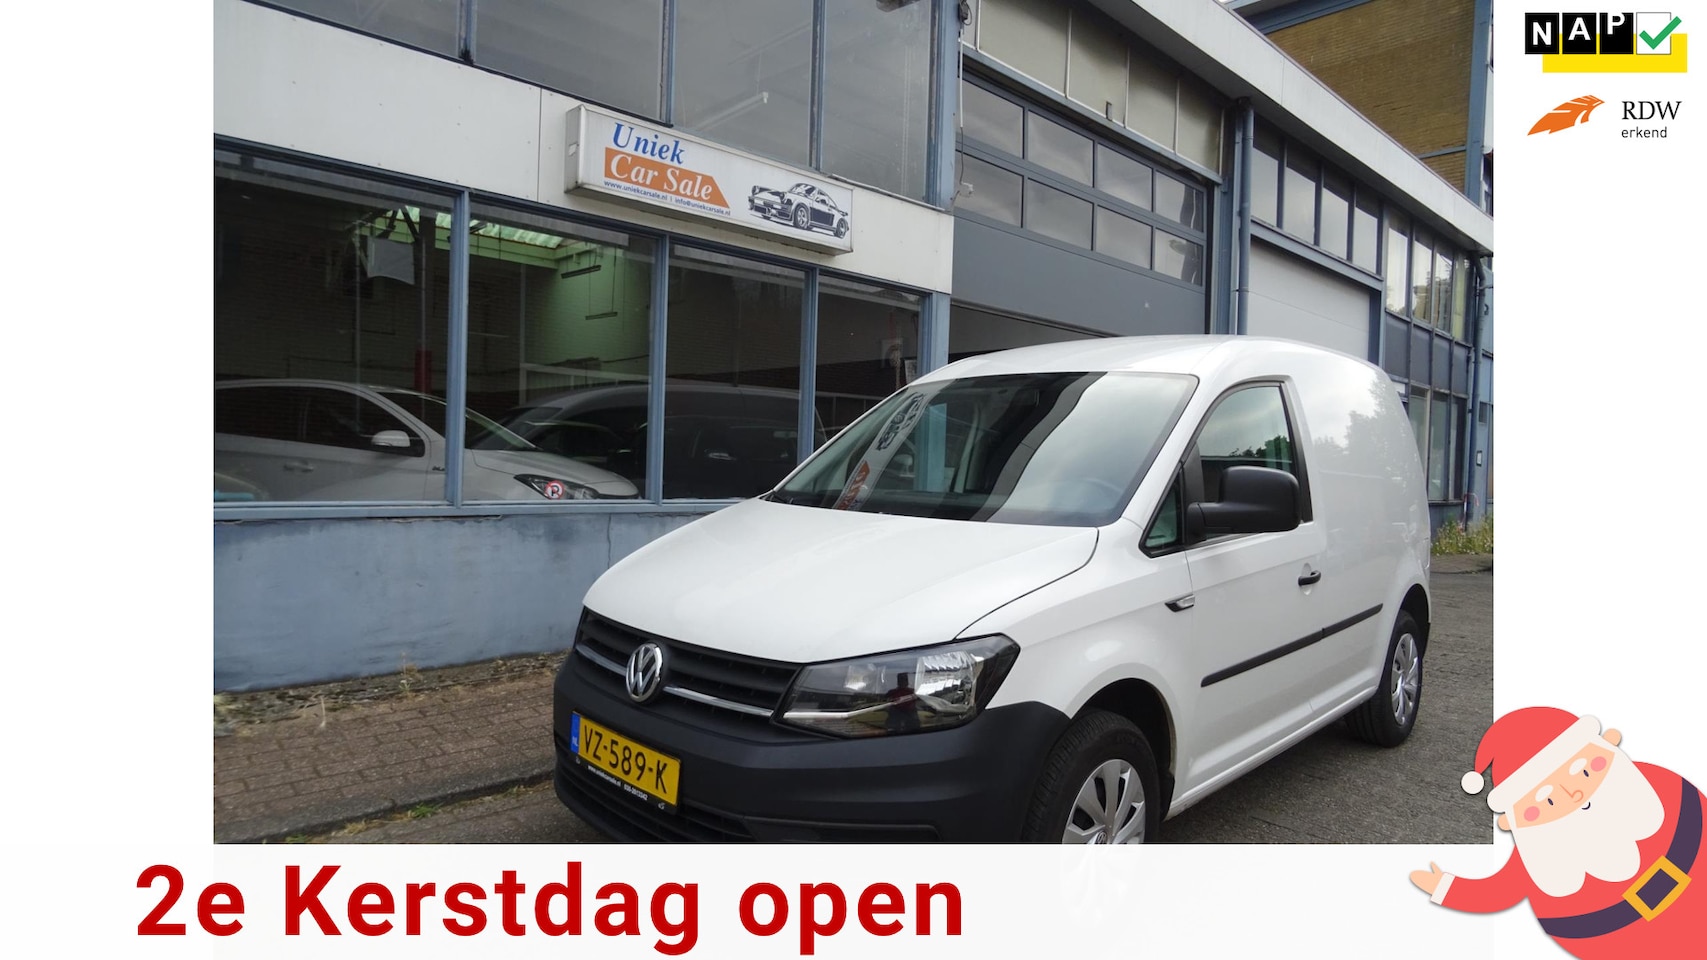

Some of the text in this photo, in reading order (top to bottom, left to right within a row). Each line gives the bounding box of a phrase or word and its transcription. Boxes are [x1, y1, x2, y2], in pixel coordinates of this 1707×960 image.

[612, 122, 685, 165] Uniek
[603, 180, 731, 217] www.uniekcarsale.nl info@uniekcarsale.nl
[610, 153, 713, 201] Car Sale
[584, 725, 668, 794] VZ-589-K
